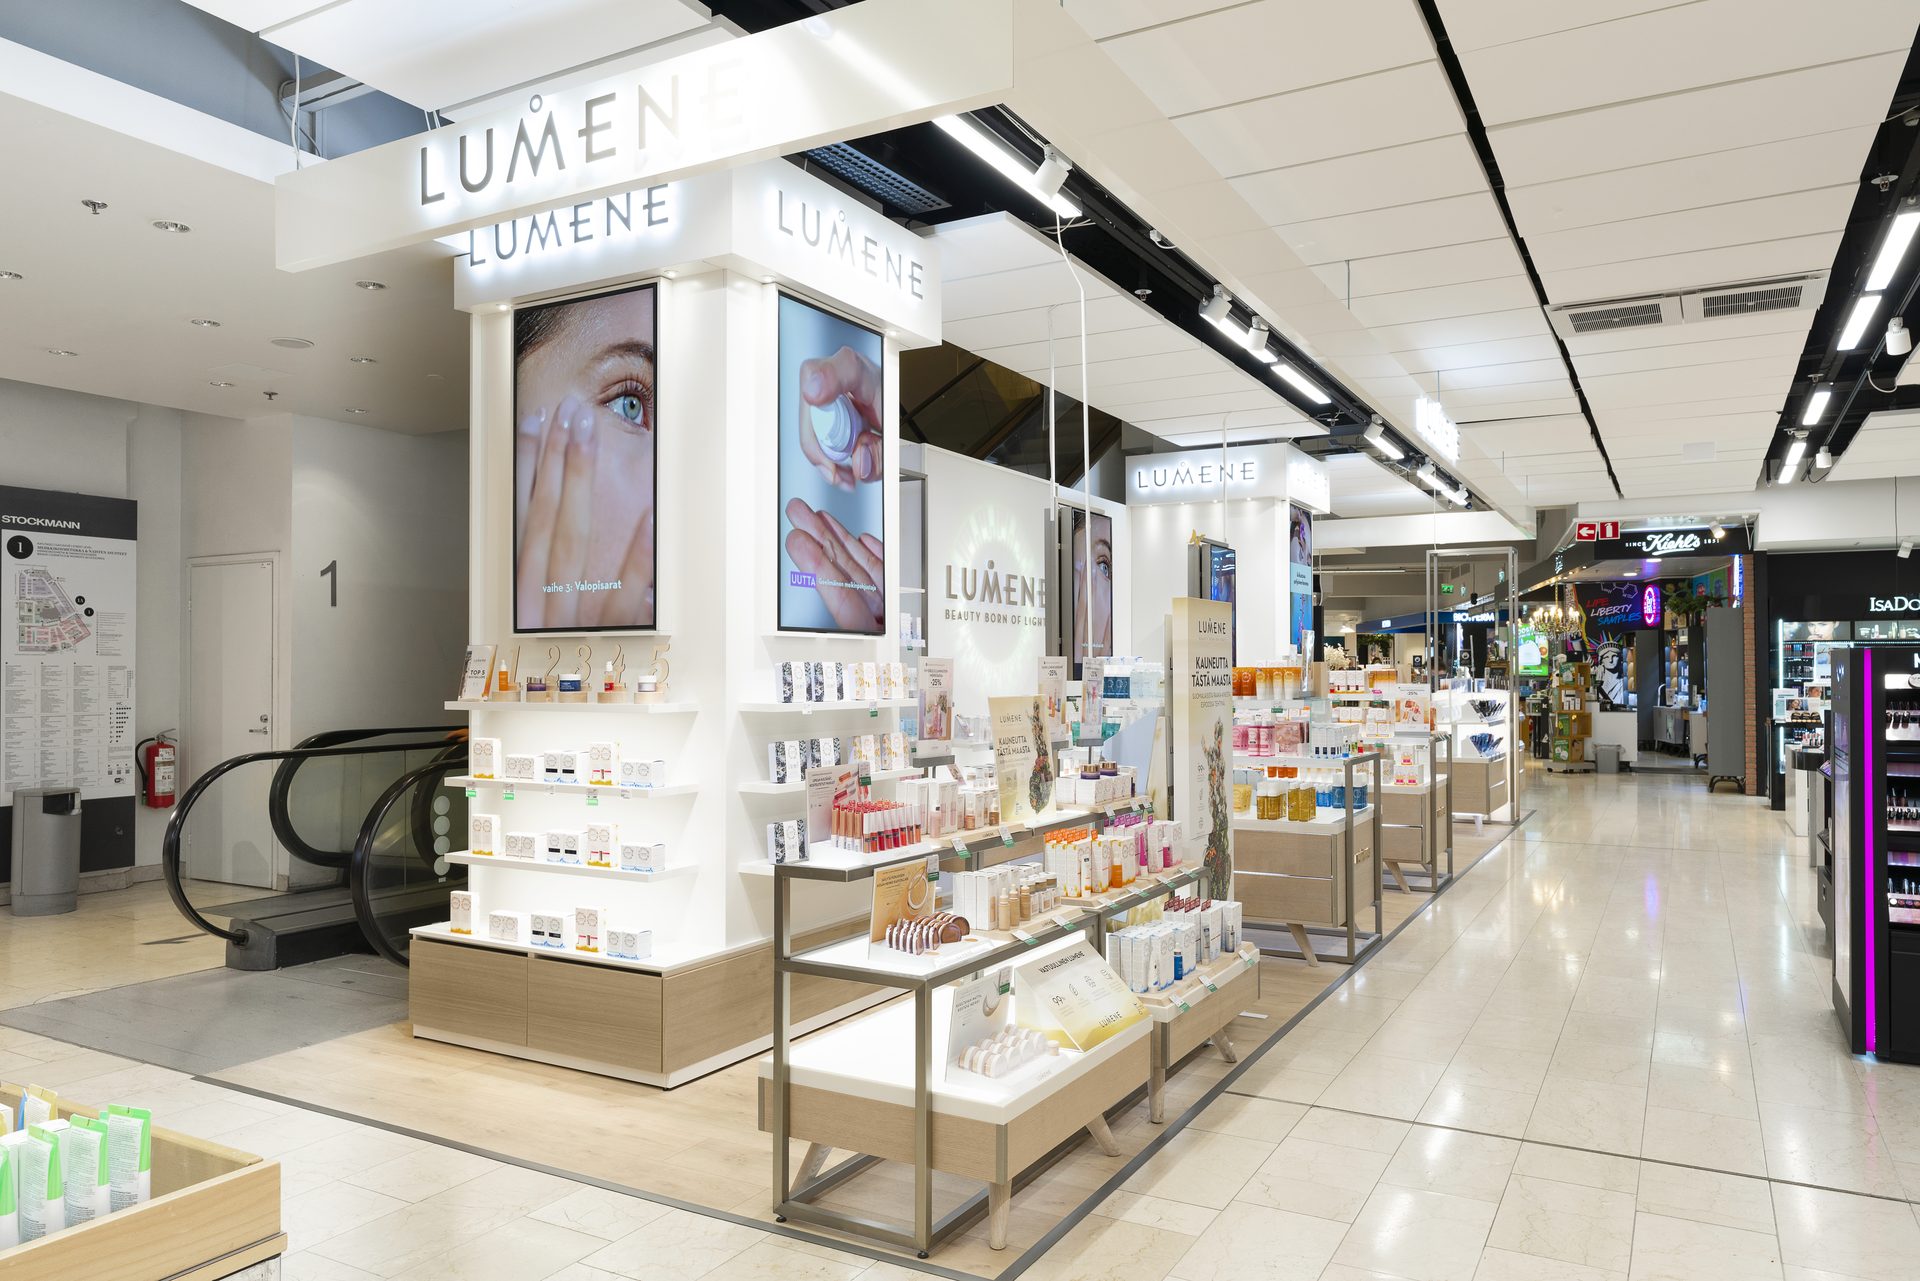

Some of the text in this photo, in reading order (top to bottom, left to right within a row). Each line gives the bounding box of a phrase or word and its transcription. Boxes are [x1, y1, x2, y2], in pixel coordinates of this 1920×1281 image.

[470, 184, 670, 268] LUMENE
[777, 189, 924, 301] LUMENE
[1137, 461, 1255, 489] LUMENE
[1, 514, 81, 530] STOCKMANN
[1642, 532, 1701, 556] Kiehl's
[320, 559, 337, 607] 1
[542, 582, 564, 593] vaihe
[574, 580, 622, 592] Valopisarat
[791, 573, 816, 587] UUTTA
[945, 559, 1045, 609] LUMENE
[944, 608, 981, 622] BEAUTY
[984, 613, 1008, 624] BORN
[1010, 615, 1022, 624] OF
[1590, 604, 1633, 617] LIBERTY
[1198, 618, 1226, 635] LUMENE
[1196, 656, 1228, 670] KAUNEUTTA
[1192, 671, 1231, 687] TÄSTÄ MAASTA
[999, 712, 1022, 724] LUMENE
[998, 735, 1027, 746] KAUNEUTTA
[1099, 1011, 1123, 1028] LUMENE
